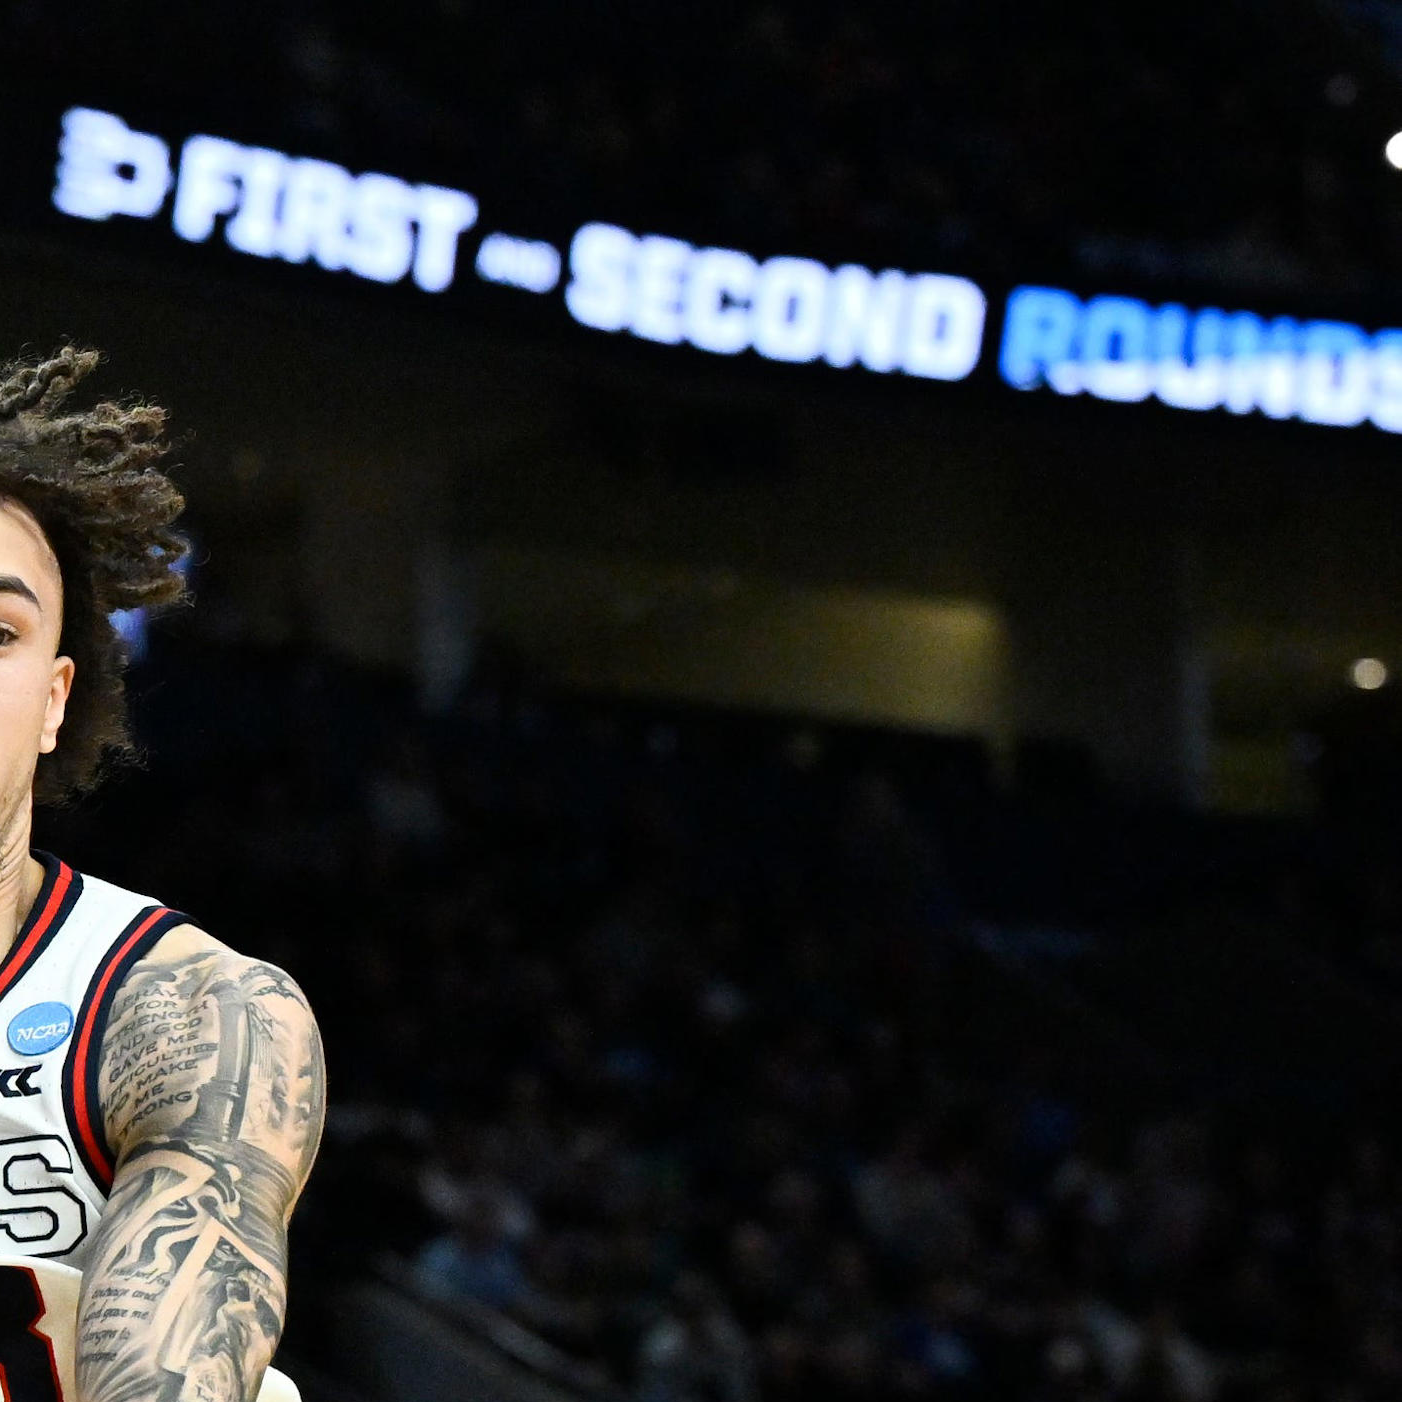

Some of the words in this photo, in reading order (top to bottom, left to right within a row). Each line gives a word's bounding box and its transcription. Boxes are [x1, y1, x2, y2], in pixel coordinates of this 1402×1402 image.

[172, 134, 478, 293] FIRST
[565, 220, 988, 382] SECOND
[134, 1000, 178, 1015] FOR
[16, 1021, 69, 1043] NCAA
[153, 1016, 202, 1035] GOD
[109, 1041, 158, 1083] GAVE
[167, 1030, 200, 1046] ME
[137, 1059, 199, 1090] MAKE
[135, 1081, 165, 1109] ME
[116, 1090, 193, 1137] TRONG
